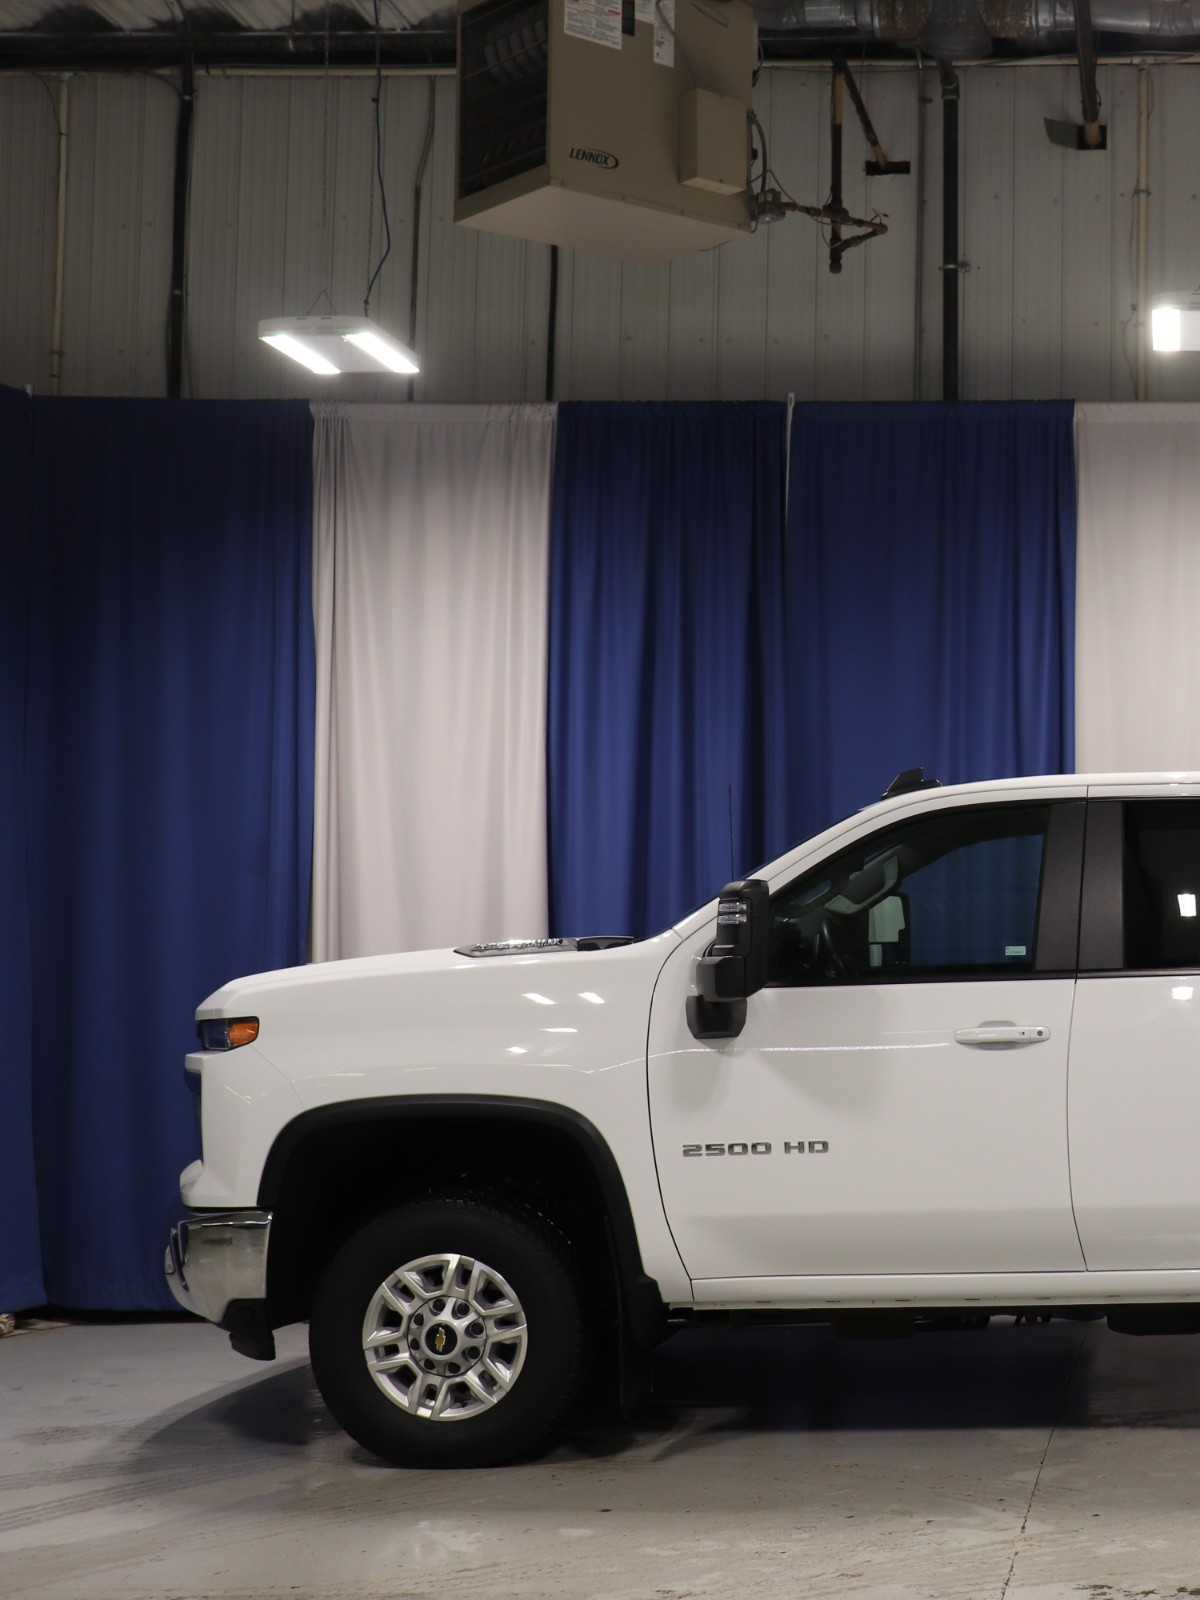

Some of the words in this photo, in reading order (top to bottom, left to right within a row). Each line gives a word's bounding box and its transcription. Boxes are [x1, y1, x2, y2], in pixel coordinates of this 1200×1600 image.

[569, 148, 609, 166] LENNOX
[682, 1142, 772, 1157] 2500
[784, 1140, 829, 1154] HD
